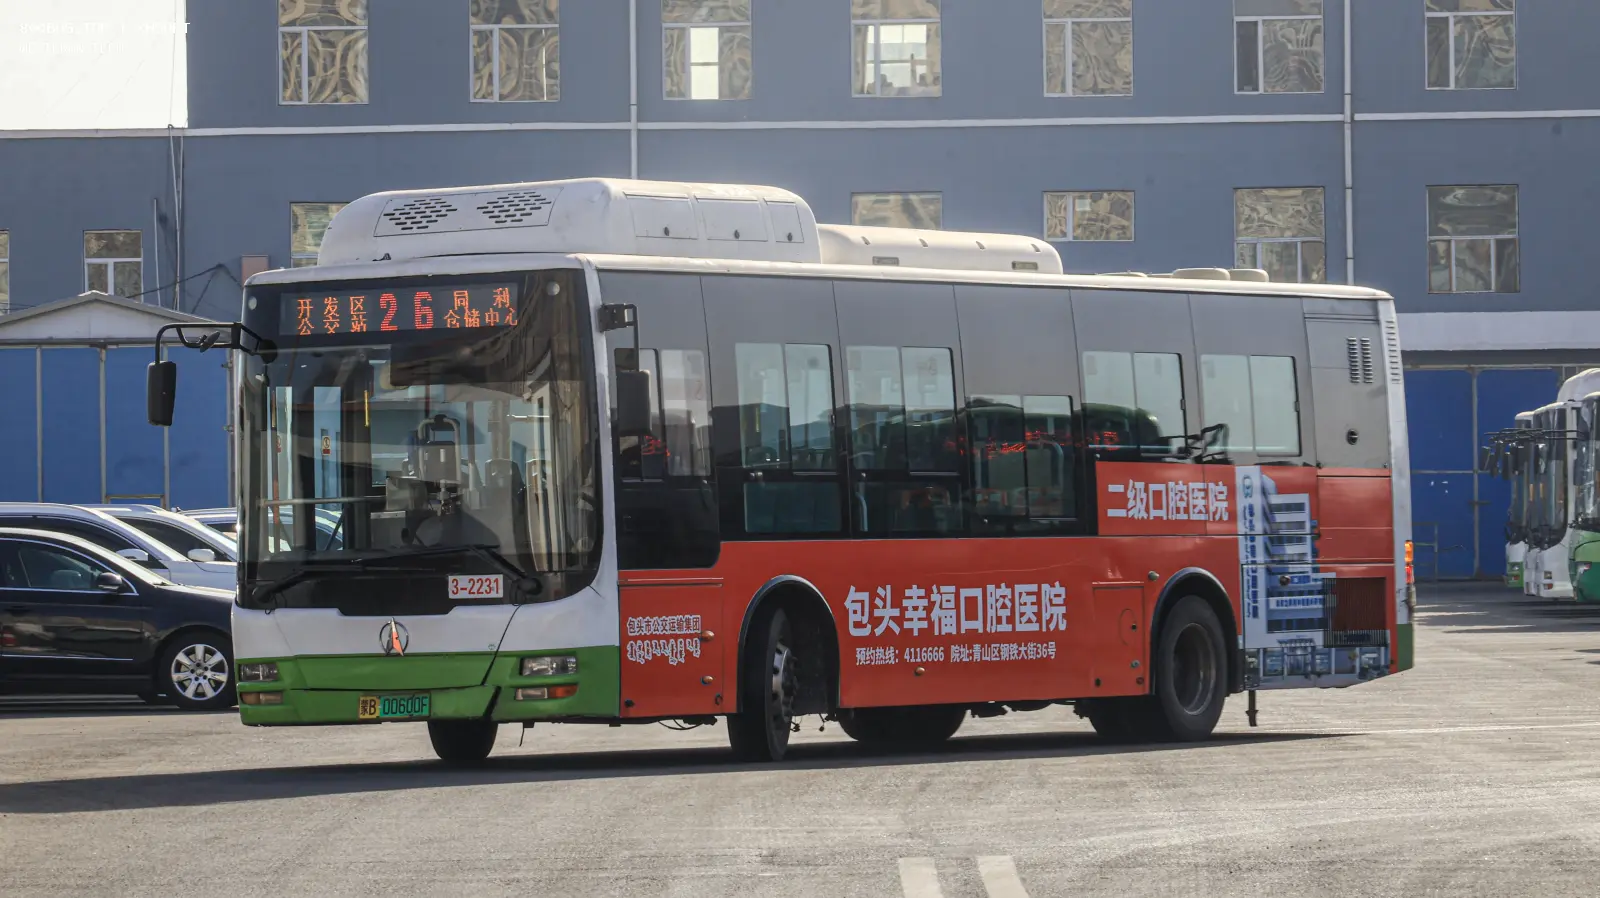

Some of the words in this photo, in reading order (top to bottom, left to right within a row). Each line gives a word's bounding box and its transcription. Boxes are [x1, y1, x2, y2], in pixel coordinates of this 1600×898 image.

[297, 295, 367, 318] 开发区
[453, 287, 510, 310] 同利
[380, 291, 434, 331] 26
[444, 307, 518, 329] 仓储中心
[297, 314, 368, 336] 公交站
[1107, 479, 1229, 521] 二级口腔医院
[451, 578, 500, 595] 3-2231
[844, 581, 1067, 637] 包头幸福口腔医院
[627, 614, 701, 636] 包头市公交运输集团
[904, 647, 945, 663] 4116666
